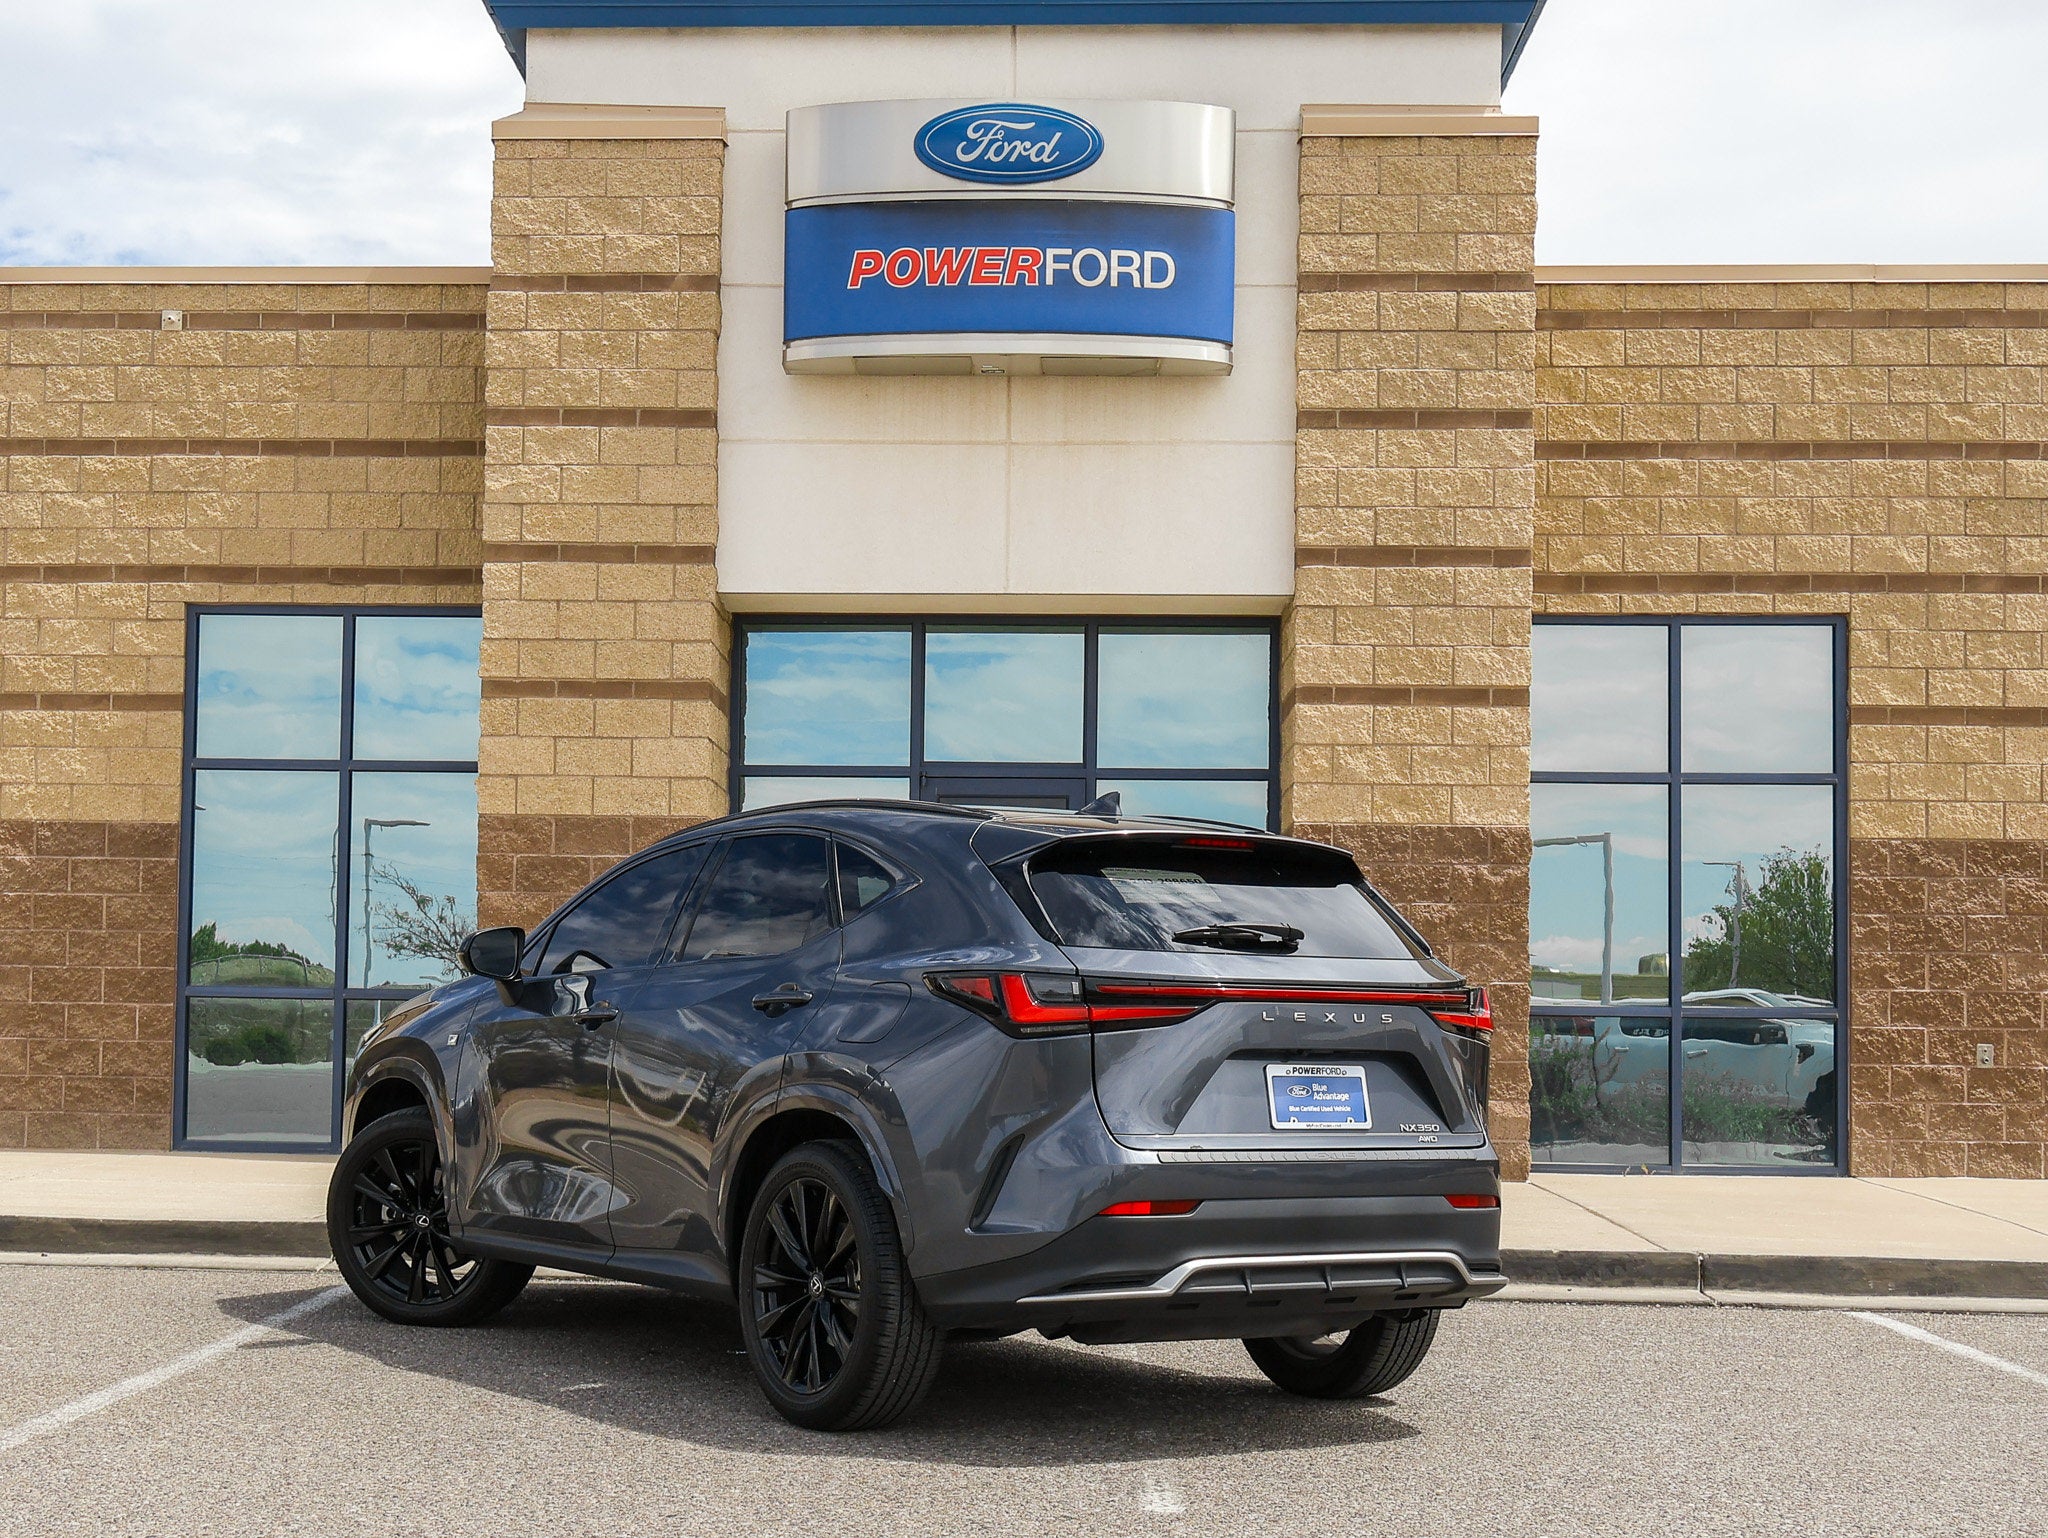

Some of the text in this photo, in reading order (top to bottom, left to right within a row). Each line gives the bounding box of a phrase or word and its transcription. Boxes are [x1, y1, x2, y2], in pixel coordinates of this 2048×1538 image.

[956, 118, 1062, 164] Ford
[846, 247, 1176, 290] POWERFORD
[1262, 1011, 1393, 1024] LEXUS
[1292, 1066, 1342, 1076] POWERFORD
[1312, 1083, 1328, 1092] Blue
[1313, 1092, 1350, 1102] Advantage
[1399, 1123, 1440, 1132] NX350
[1418, 1135, 1438, 1143] AWD
